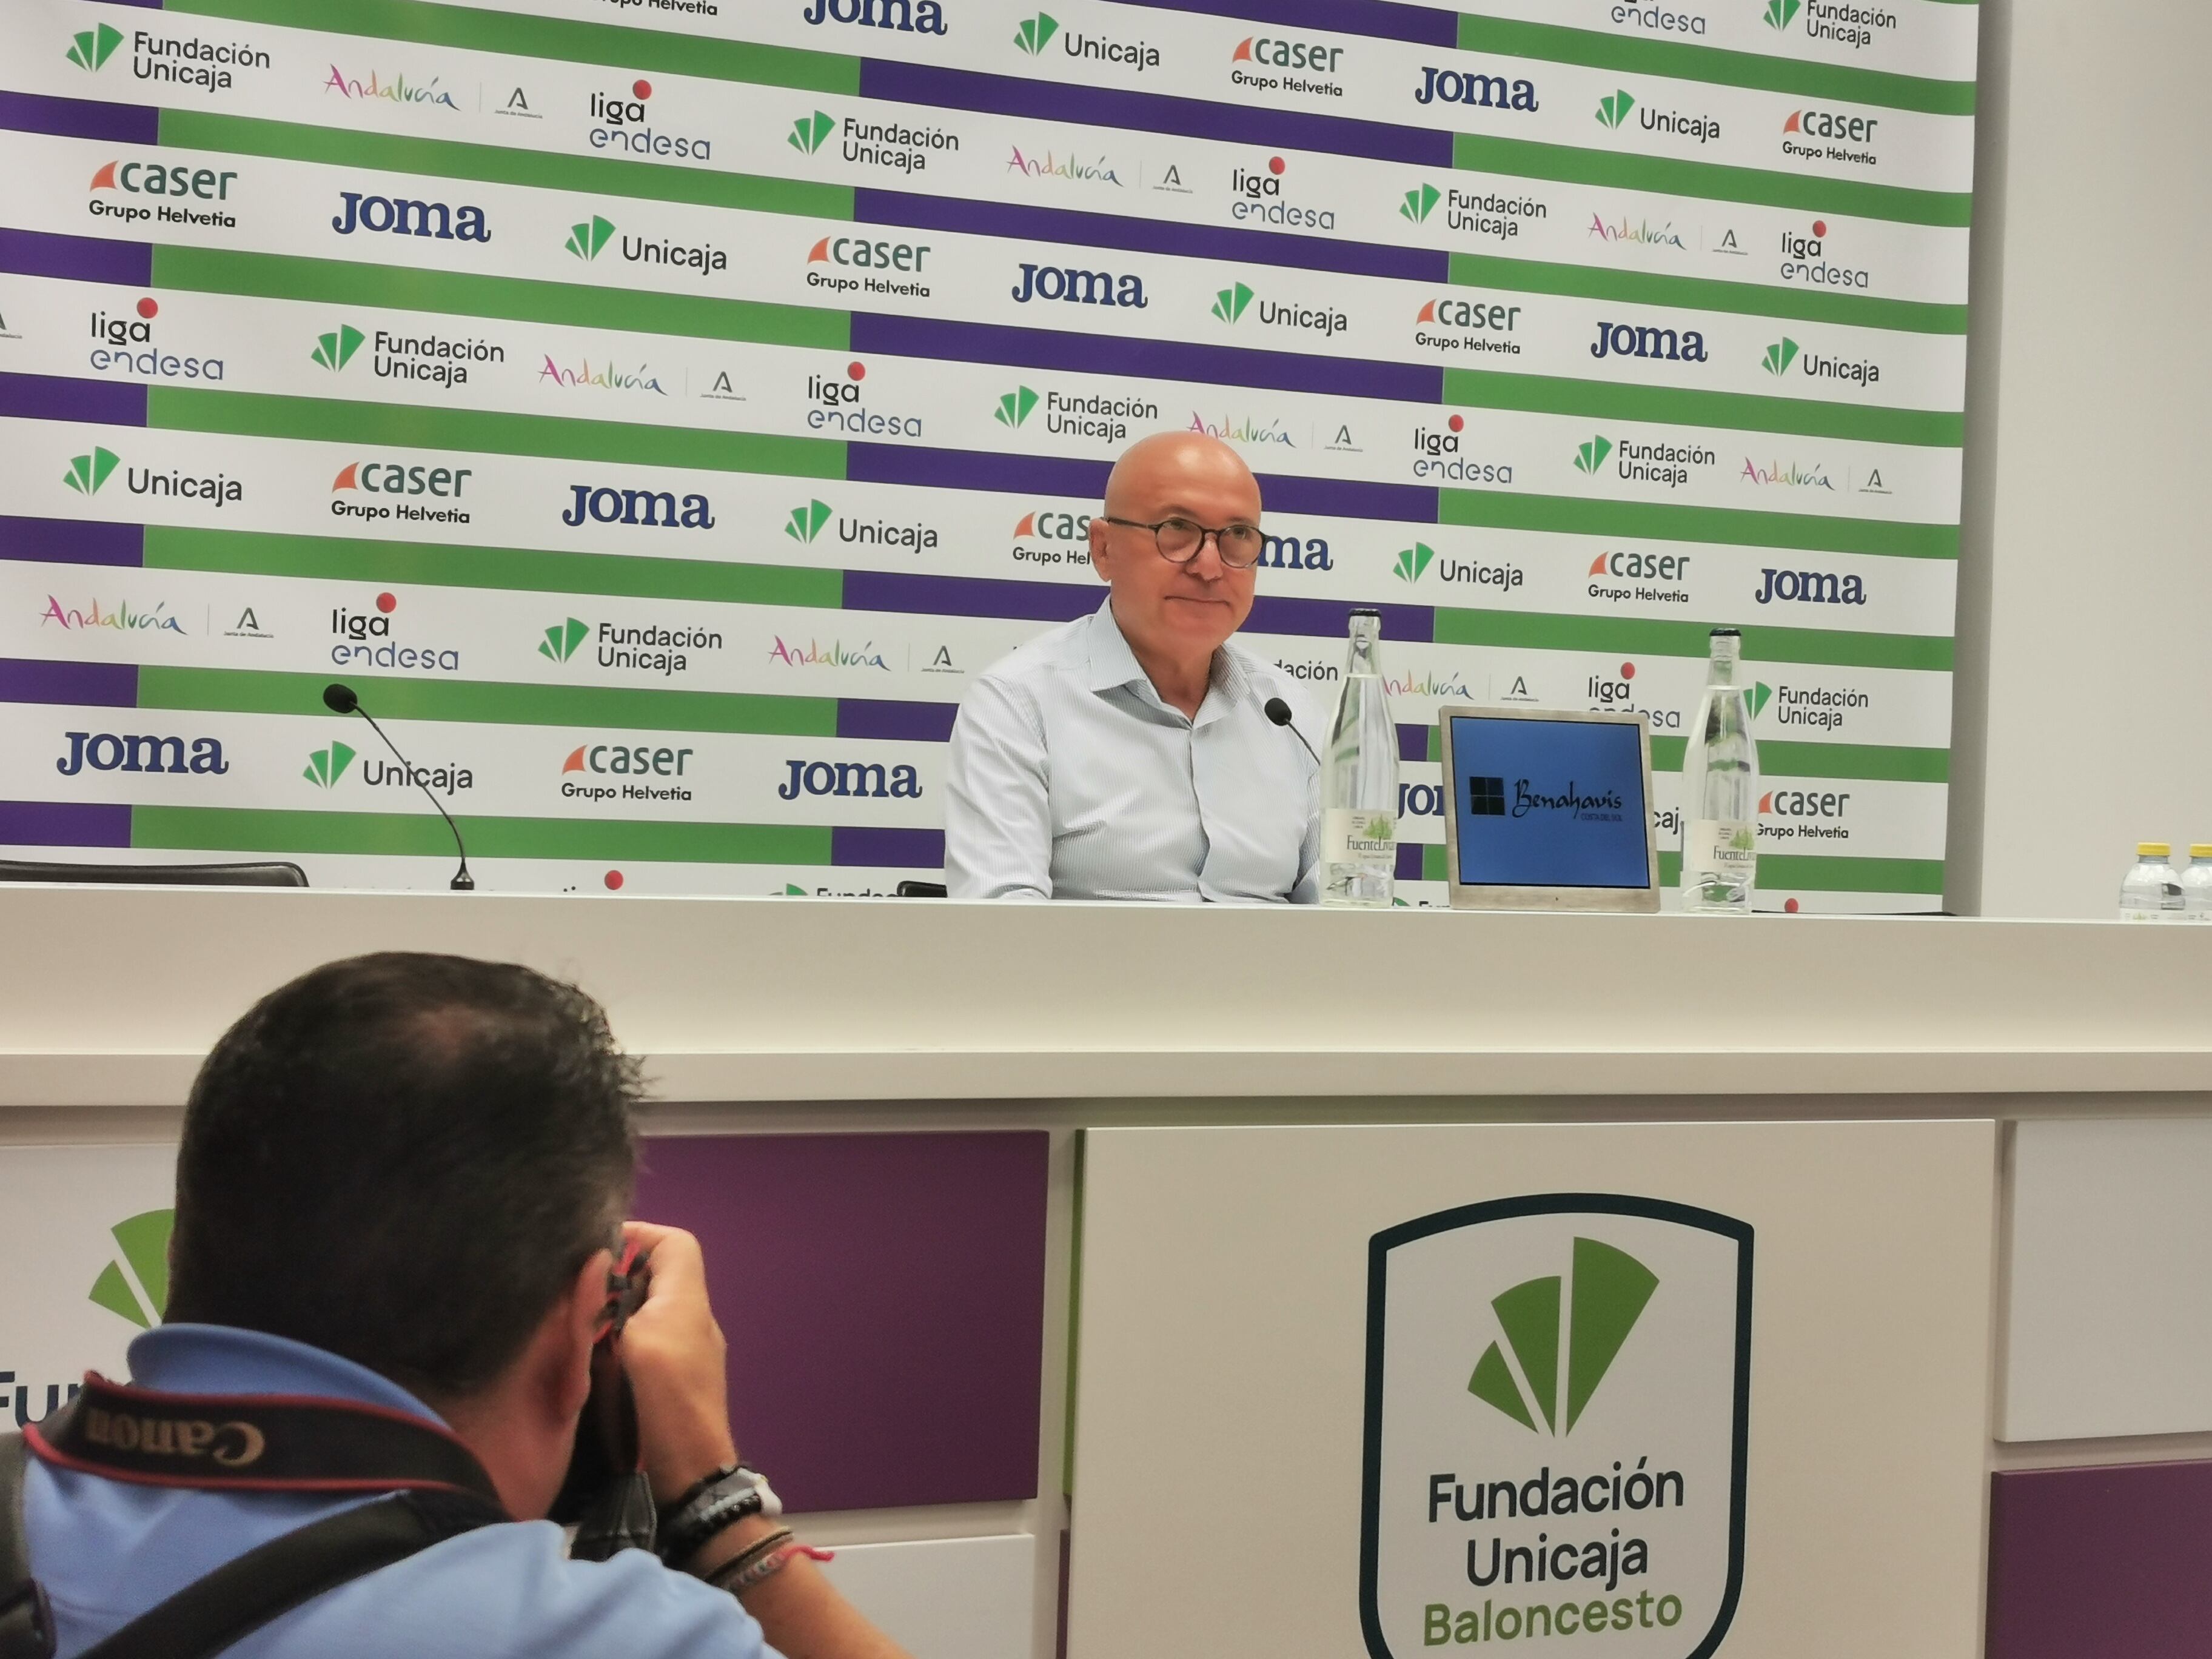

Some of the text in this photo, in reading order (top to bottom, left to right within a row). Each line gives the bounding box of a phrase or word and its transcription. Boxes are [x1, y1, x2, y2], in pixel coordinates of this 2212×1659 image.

[803, 0, 948, 36] Joma
[1611, 6, 1705, 35] endesa
[1808, 0, 1896, 29] Fundación
[1807, 15, 1871, 49] Unicaja
[133, 31, 270, 69] Fundación
[1065, 32, 1159, 72] Unicaja
[1255, 39, 1344, 73] caser
[133, 52, 231, 93] Unicaja
[324, 64, 460, 111] Andalucía
[1232, 70, 1342, 97] Grupo Helvetia
[1415, 66, 1539, 112] Joma
[591, 92, 645, 126] liga
[1641, 107, 1720, 144] Unicaja
[589, 127, 710, 160] endesa
[844, 118, 959, 152] Fundación
[1803, 112, 1878, 142] caser
[843, 136, 925, 174] Unicaja
[1007, 146, 1123, 187] Andalucía
[1783, 141, 1876, 165] Grupo Helvetia
[121, 163, 238, 200] caser
[1233, 168, 1279, 198] liga
[89, 199, 236, 227] Grupo Helvetia
[332, 192, 491, 243] Joma
[1232, 201, 1334, 230] endesa
[1449, 189, 1546, 220] Fundación
[1448, 210, 1518, 241] Unicaja
[1588, 213, 1686, 250] Andalucía
[623, 235, 726, 276] Unicaja
[833, 238, 931, 272] caser
[1782, 232, 1822, 260] liga
[807, 272, 930, 297] Grupo Helvetia
[1011, 263, 1148, 309] Joma
[1781, 261, 1868, 288] endesa
[92, 311, 150, 346] liga
[1260, 301, 1347, 337] Unicaja
[1438, 300, 1521, 331] caser
[375, 331, 504, 365] Fundación
[1415, 332, 1520, 354] Grupo Helvetia
[1590, 322, 1708, 363] Joma
[90, 348, 223, 380] endesa
[375, 355, 467, 389] Unicaja
[538, 354, 668, 396] Andalucía
[1804, 354, 1879, 387] Unicaja
[808, 374, 859, 406] liga
[1048, 392, 1158, 419] Fundación
[808, 407, 922, 437] endesa
[1048, 414, 1125, 444] Unicaja
[1415, 427, 1458, 456] liga
[1620, 440, 1715, 466] Fundación
[361, 463, 472, 497] caser
[1413, 457, 1512, 483] endesa
[1619, 461, 1687, 488] Unicaja
[1741, 457, 1835, 491] Andalucía
[129, 468, 242, 508] Unicaja
[332, 500, 470, 523] Grupo Helvetia
[562, 485, 715, 529] Joma
[840, 518, 937, 554] Unicaja
[1037, 511, 1089, 541] cas
[1013, 546, 1061, 566] Grupo
[1258, 534, 1333, 571] ma
[1610, 552, 1690, 580] caser
[1440, 559, 1523, 592] Unicaja
[1755, 568, 1867, 605] Joma
[1588, 585, 1688, 602] Grupo Helvetia
[40, 594, 187, 635] Andalucía
[333, 607, 389, 640] liga
[599, 623, 722, 651] Fundación
[769, 635, 891, 671] Andalucía
[332, 641, 458, 671] endesa
[598, 646, 686, 676] Unicaja
[1589, 677, 1630, 703] liga
[1779, 686, 1868, 710] Fundación
[1778, 706, 1842, 731] Unicaja
[56, 732, 229, 776] Joma
[589, 746, 693, 776] caser
[363, 760, 473, 797] Unicaja
[561, 783, 691, 802] Grupo Helvetia
[778, 760, 923, 800] Joma
[1398, 783, 1444, 819] Jo
[1775, 791, 1850, 817] caser
[1798, 825, 1849, 839] Helvetia
[85, 1408, 265, 1467] Canon
[1429, 1456, 1684, 1523] Fundación
[1466, 1528, 1648, 1591] Unicaja
[1423, 1588, 1682, 1646] Baloncesto
